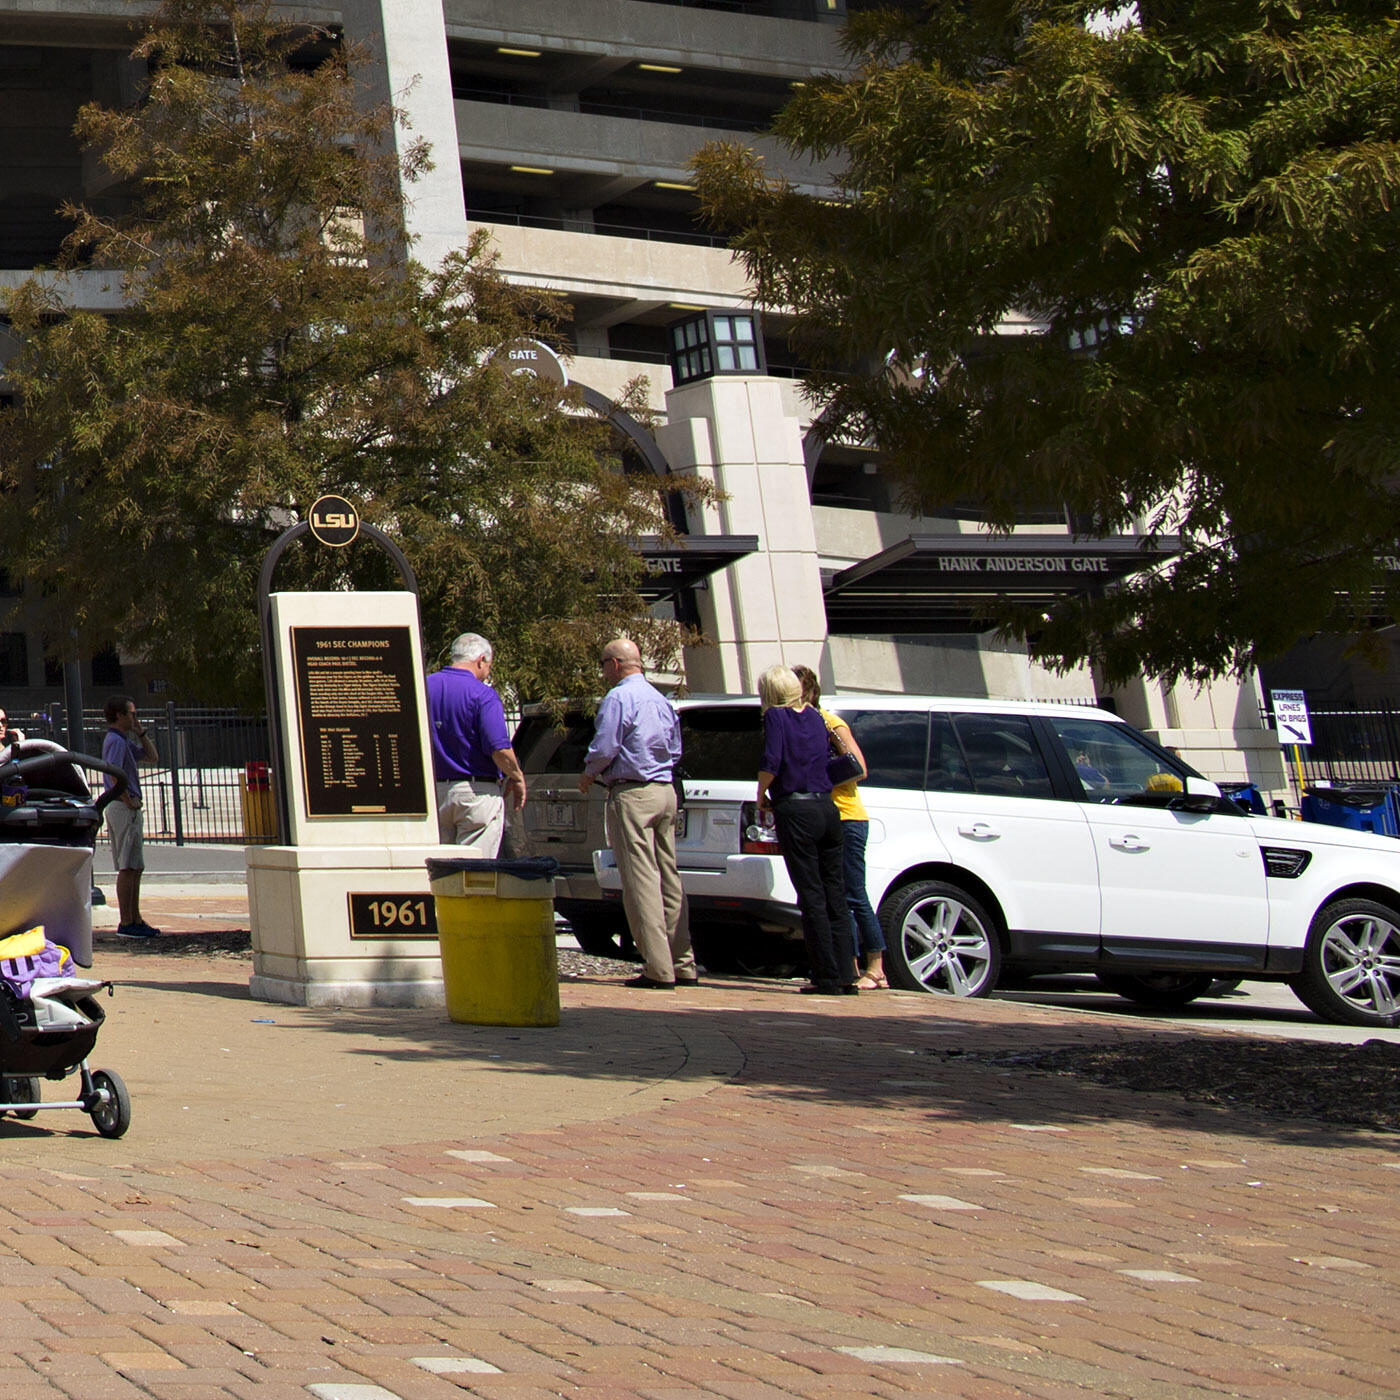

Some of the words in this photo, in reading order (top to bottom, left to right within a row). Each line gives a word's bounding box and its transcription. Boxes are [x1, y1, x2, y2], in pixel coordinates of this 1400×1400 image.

[508, 350, 538, 360] GATE
[313, 513, 355, 529] LSU
[938, 557, 979, 572] HANK
[985, 557, 1067, 572] ANDERSON
[1071, 557, 1109, 572] GATE
[333, 640, 347, 648] SEC
[347, 640, 390, 648] CHAMPIONS
[1279, 703, 1301, 711] LANES
[1277, 714, 1287, 722] NO
[685, 789, 710, 797] VER
[368, 900, 427, 927] 1961
